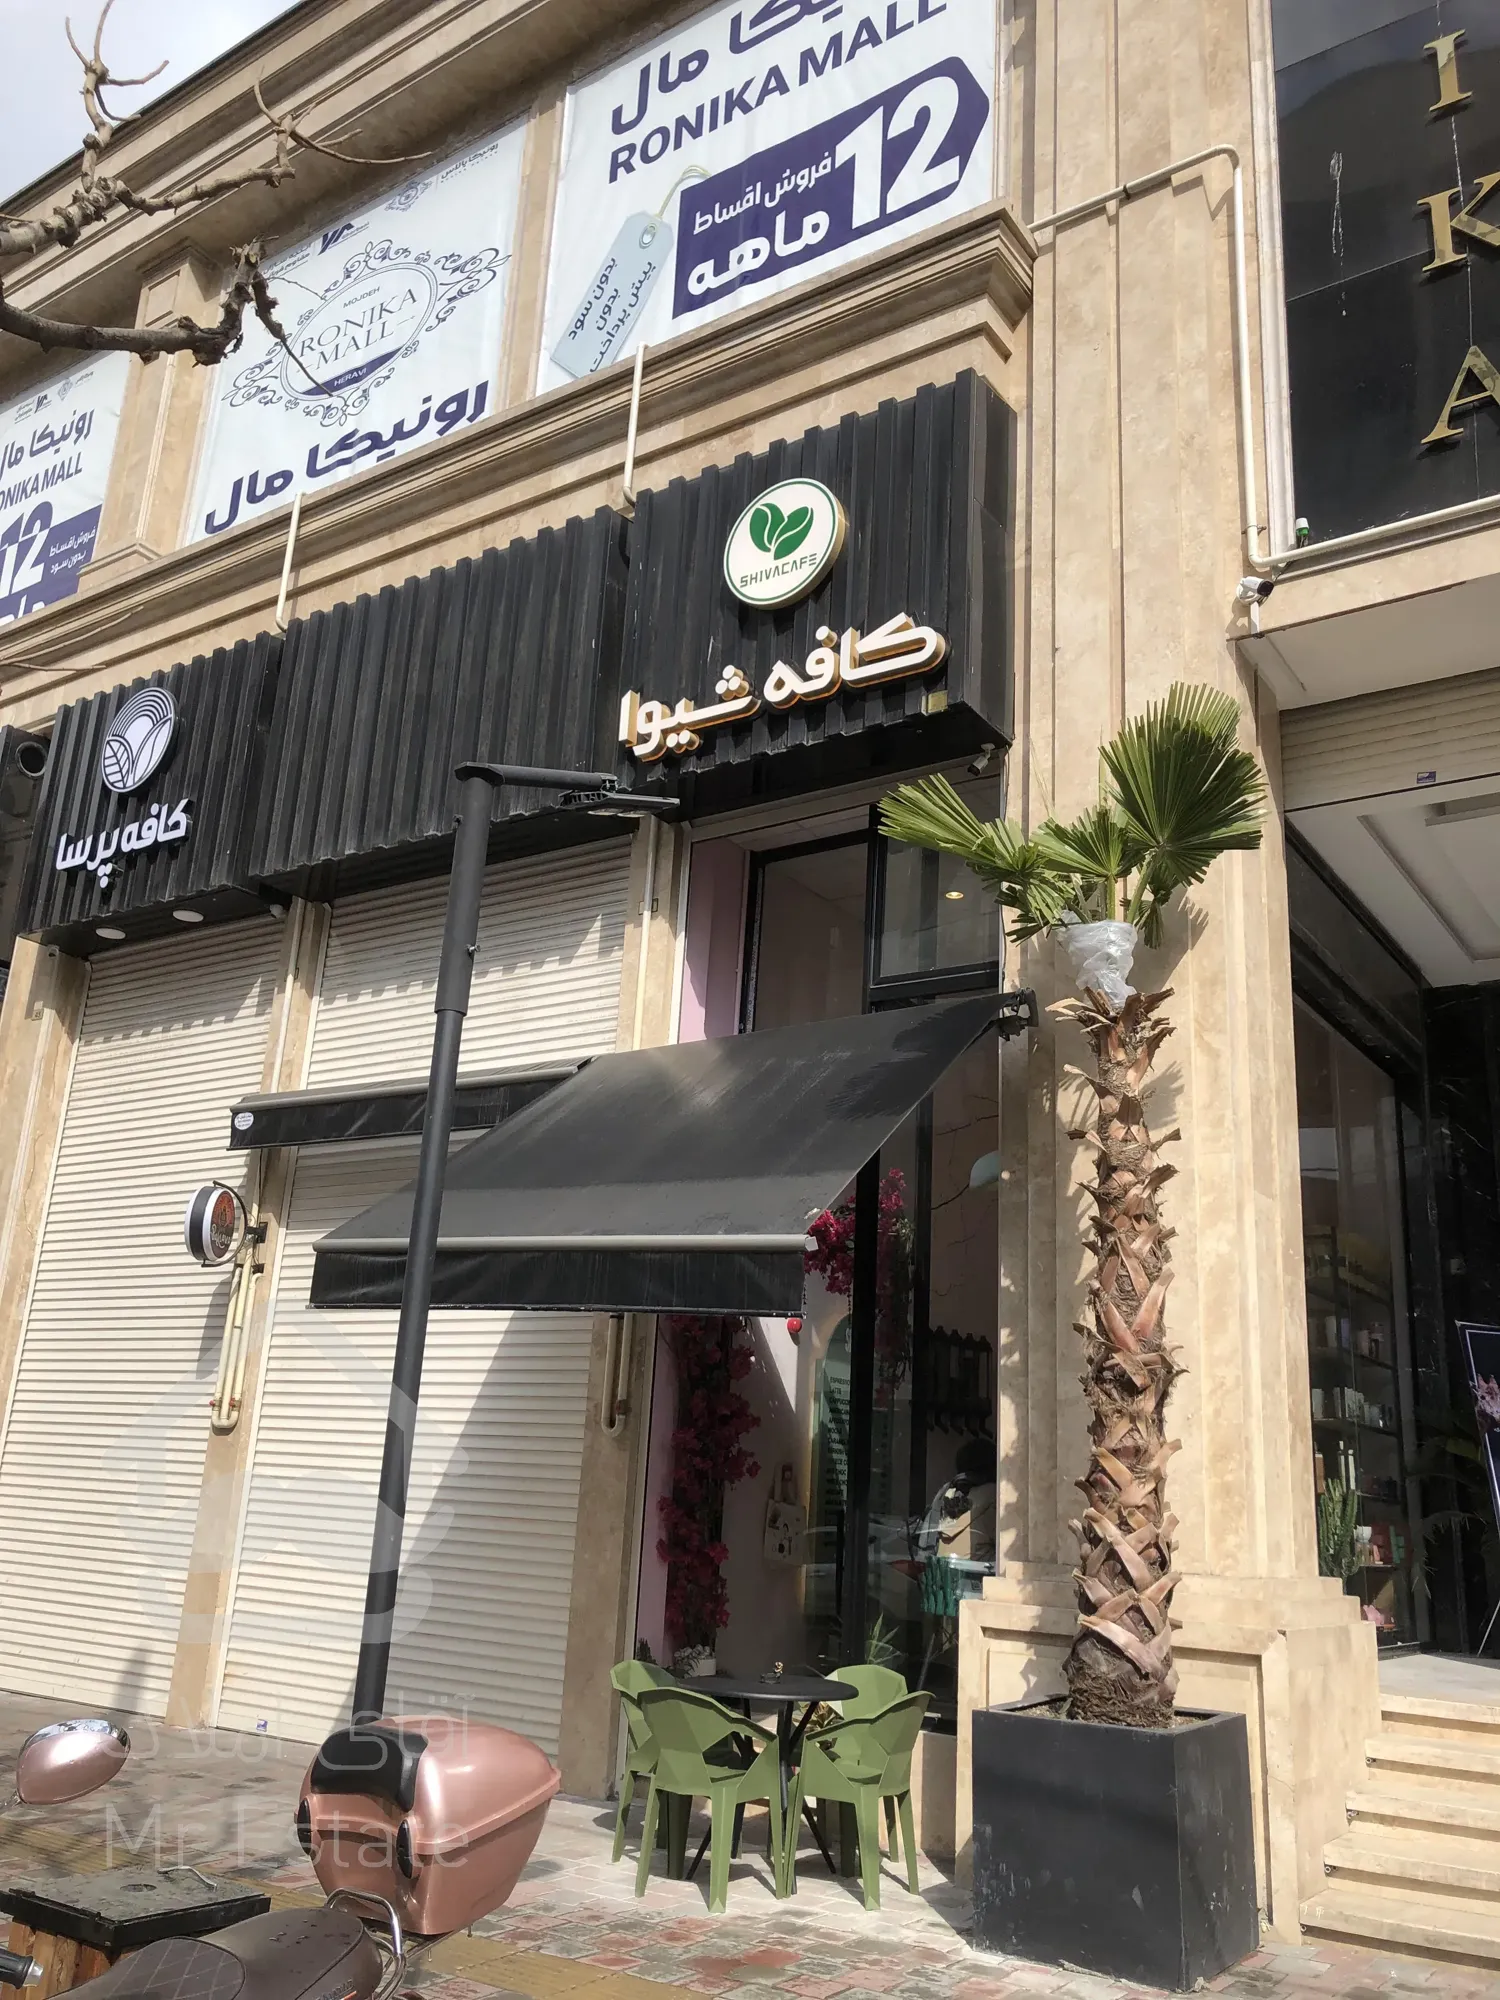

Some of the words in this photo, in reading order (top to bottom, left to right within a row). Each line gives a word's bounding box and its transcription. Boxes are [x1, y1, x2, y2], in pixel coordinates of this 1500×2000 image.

[608, 65, 790, 183] RONIKA
[799, 0, 947, 86] MALL
[611, 45, 709, 136] مال
[763, 150, 834, 208] فروش
[835, 75, 961, 231] 12
[692, 182, 761, 235] اقساط
[593, 257, 618, 300] بدون
[687, 210, 831, 297] ماهه
[299, 288, 418, 358] RONIKA
[343, 286, 381, 308] MOJDEH
[568, 300, 593, 340] سود
[596, 288, 621, 331] بدون
[316, 320, 395, 370] MALL
[333, 367, 368, 387] HERAVI
[29, 408, 95, 458] رونیکا
[306, 380, 490, 479] رونیکا
[41, 451, 83, 492] MALL
[205, 468, 294, 534] مال
[763, 611, 944, 708] کافه
[618, 664, 760, 761] شیوا
[121, 798, 190, 854] کافه
[55, 827, 120, 889] پرسا
